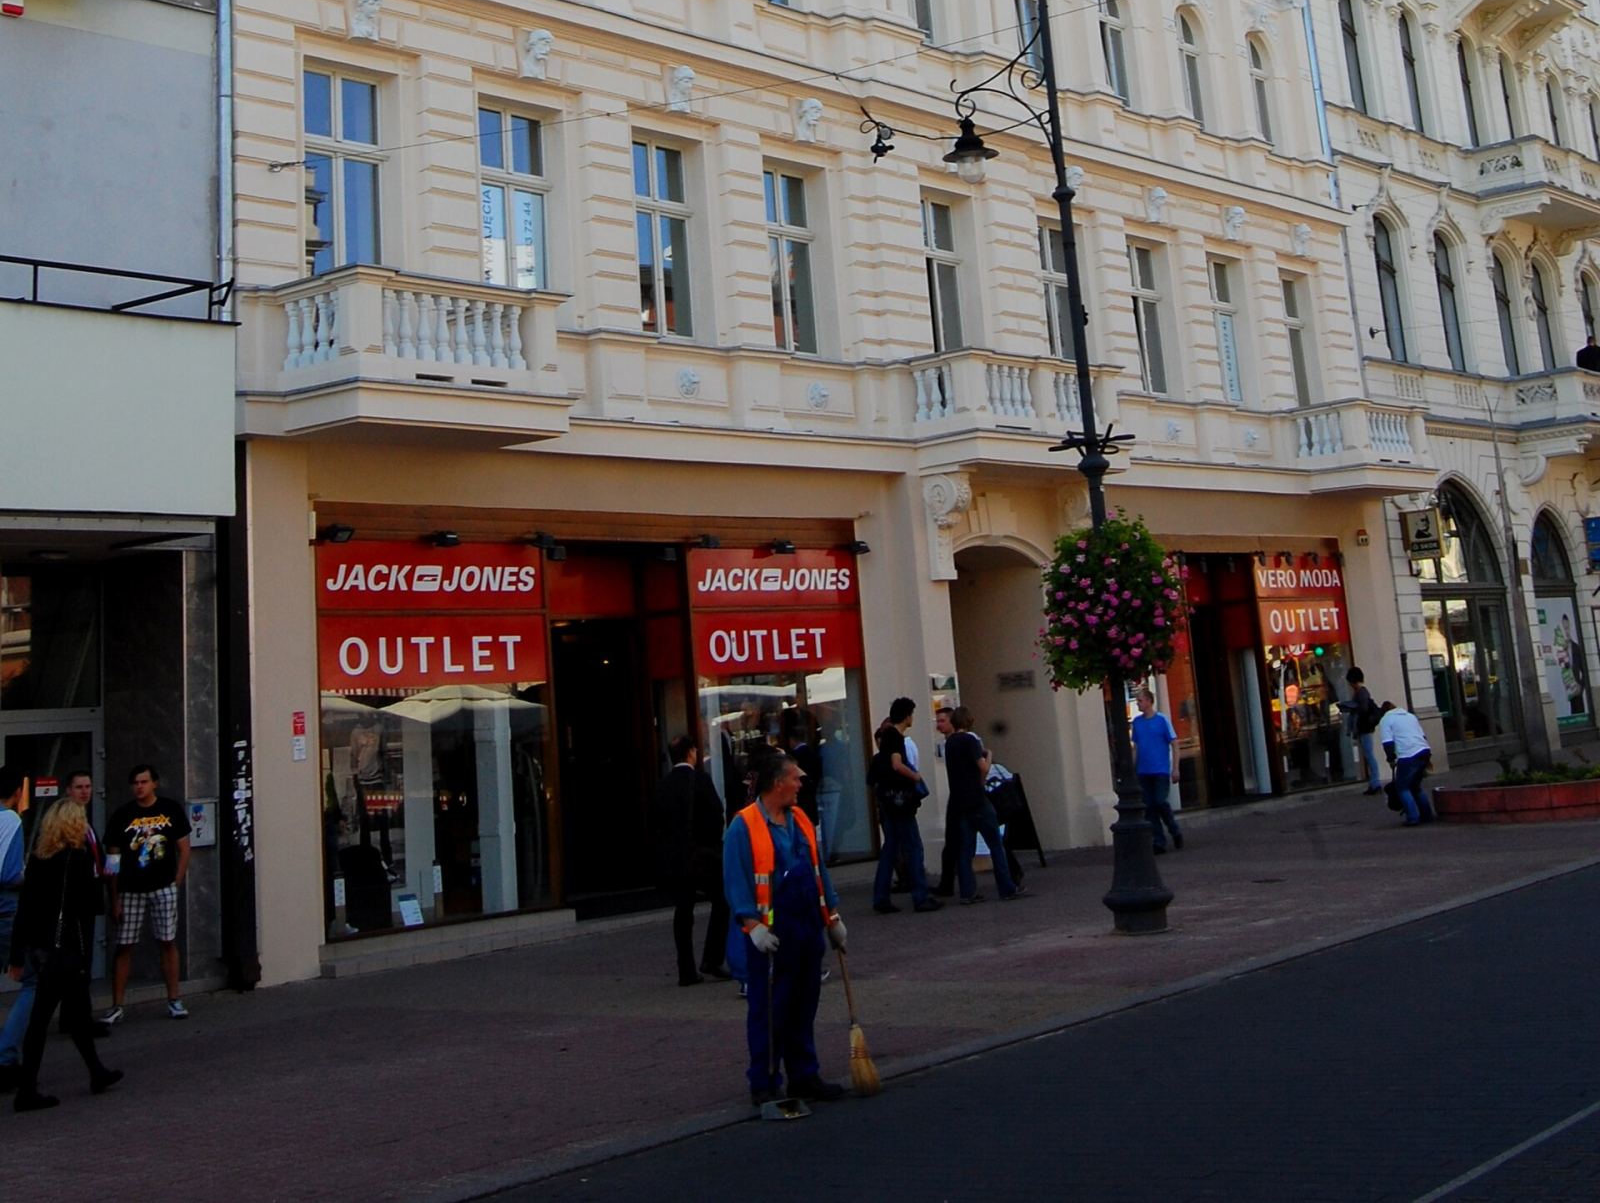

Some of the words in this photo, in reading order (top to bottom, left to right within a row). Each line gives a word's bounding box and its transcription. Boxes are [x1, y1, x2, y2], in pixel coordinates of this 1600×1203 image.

[326, 564, 411, 591] JACK
[442, 565, 535, 592] JONES
[698, 568, 761, 592] JACK
[782, 568, 850, 591] JONES
[1257, 569, 1297, 588] VERO
[1300, 569, 1341, 588] MODA
[1269, 607, 1339, 633] OUTLET
[338, 635, 521, 675] OUTLET
[709, 628, 827, 663] OUTLET
